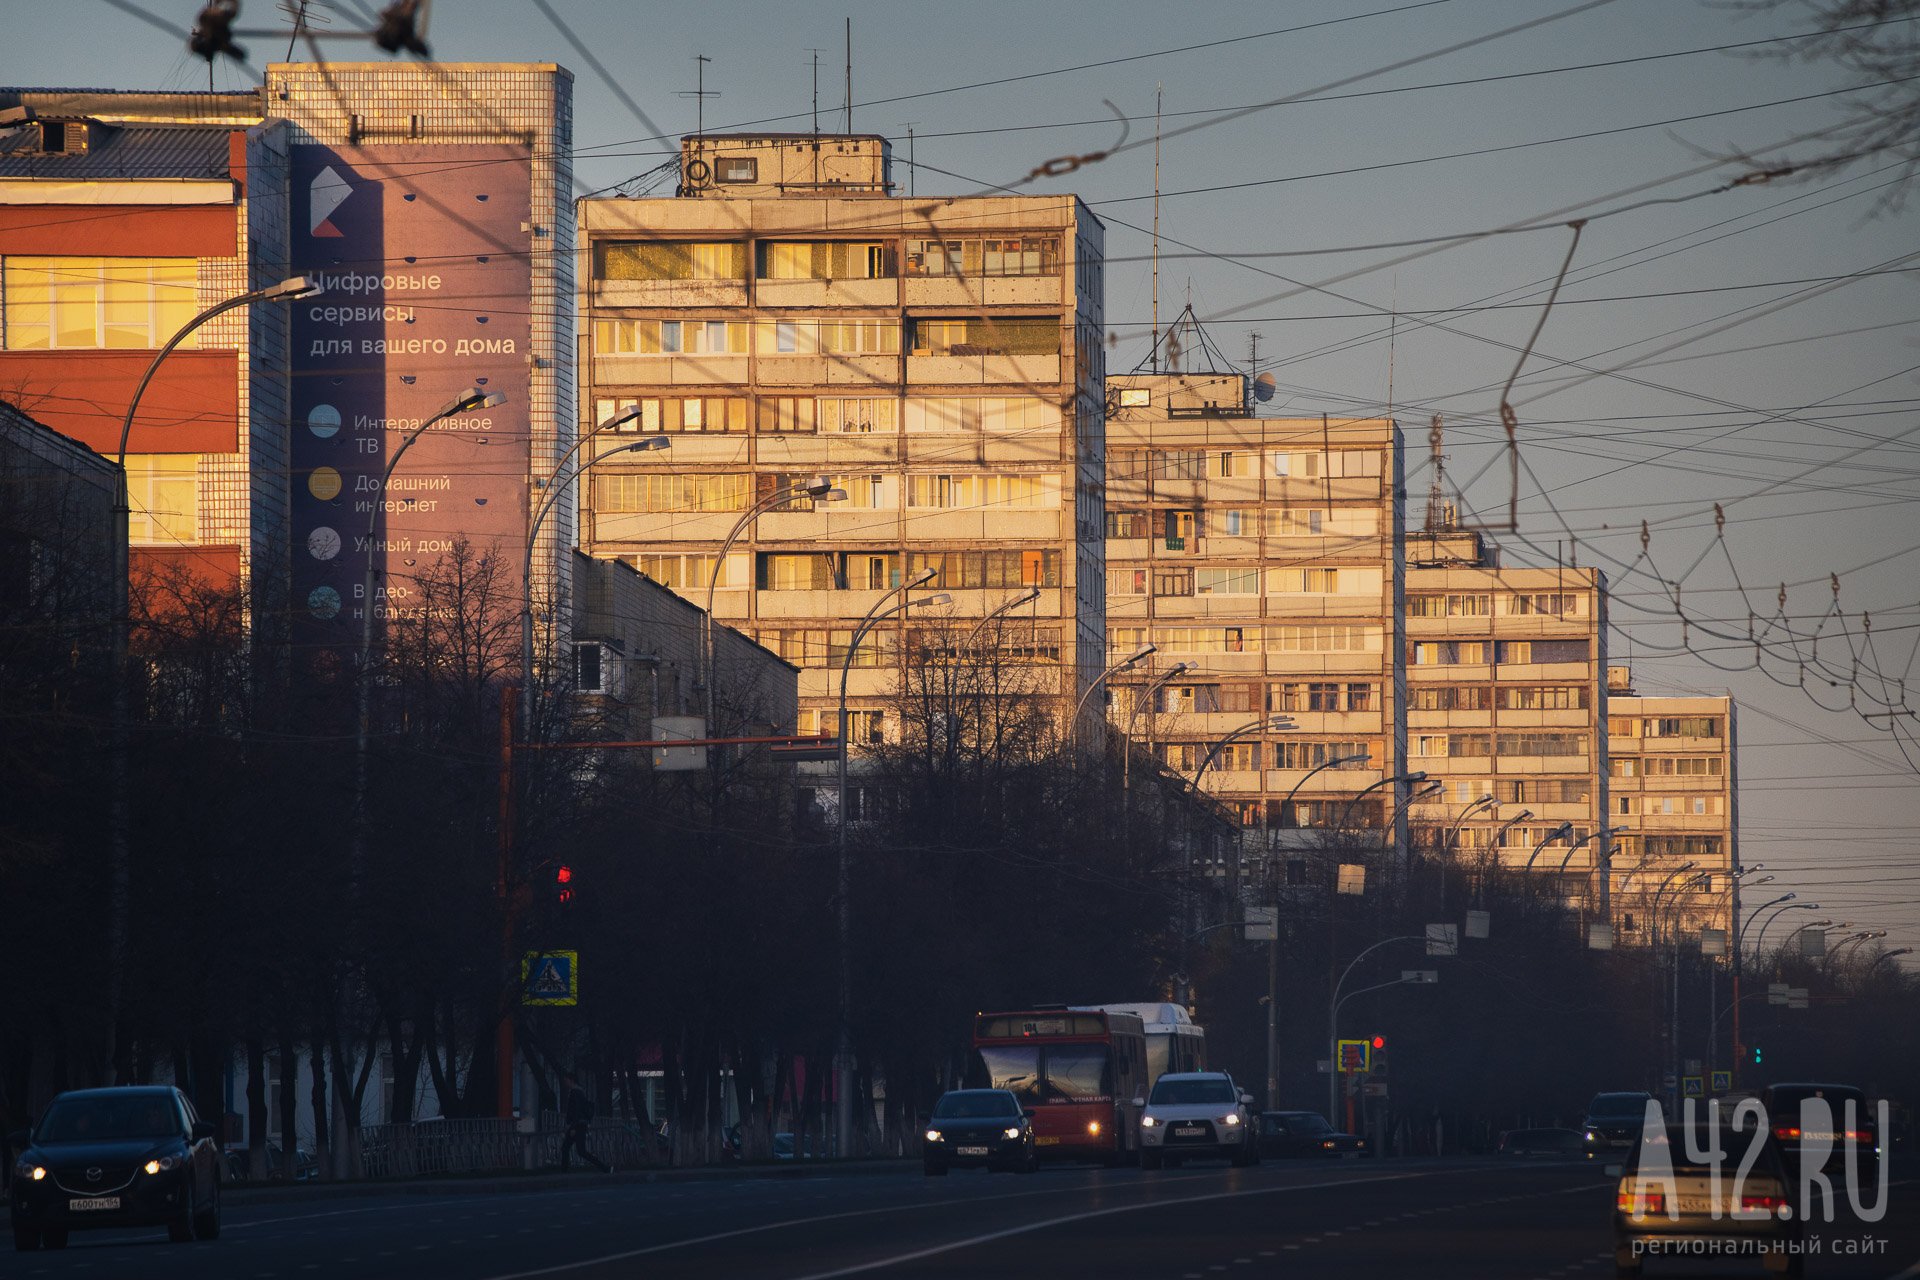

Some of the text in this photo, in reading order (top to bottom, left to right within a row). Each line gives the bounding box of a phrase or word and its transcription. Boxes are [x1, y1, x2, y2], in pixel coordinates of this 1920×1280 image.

[309, 270, 441, 295] Цифровые
[309, 306, 414, 326] сервисы
[310, 338, 516, 357] для вашего дома
[354, 415, 492, 434] Интеративное
[355, 438, 379, 454] ТВ
[417, 540, 453, 554] дом
[354, 583, 413, 601] Вдео-
[353, 604, 457, 619] нблюдение
